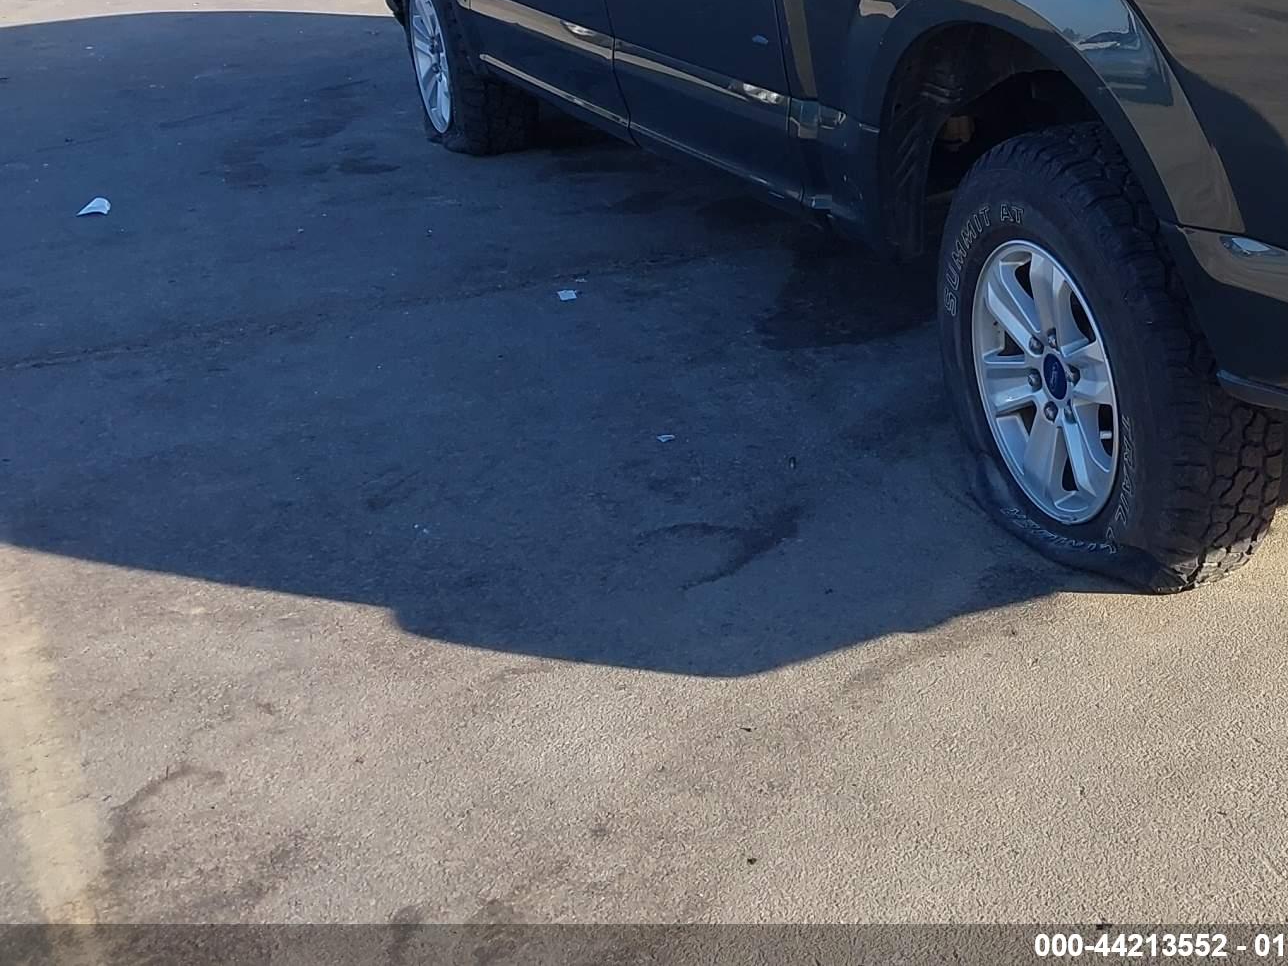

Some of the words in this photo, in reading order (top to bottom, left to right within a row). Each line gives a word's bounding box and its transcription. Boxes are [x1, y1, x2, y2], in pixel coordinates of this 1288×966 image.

[944, 204, 992, 317] SUMMIT
[1000, 202, 1024, 224] AT
[1114, 414, 1137, 526] TRAIL
